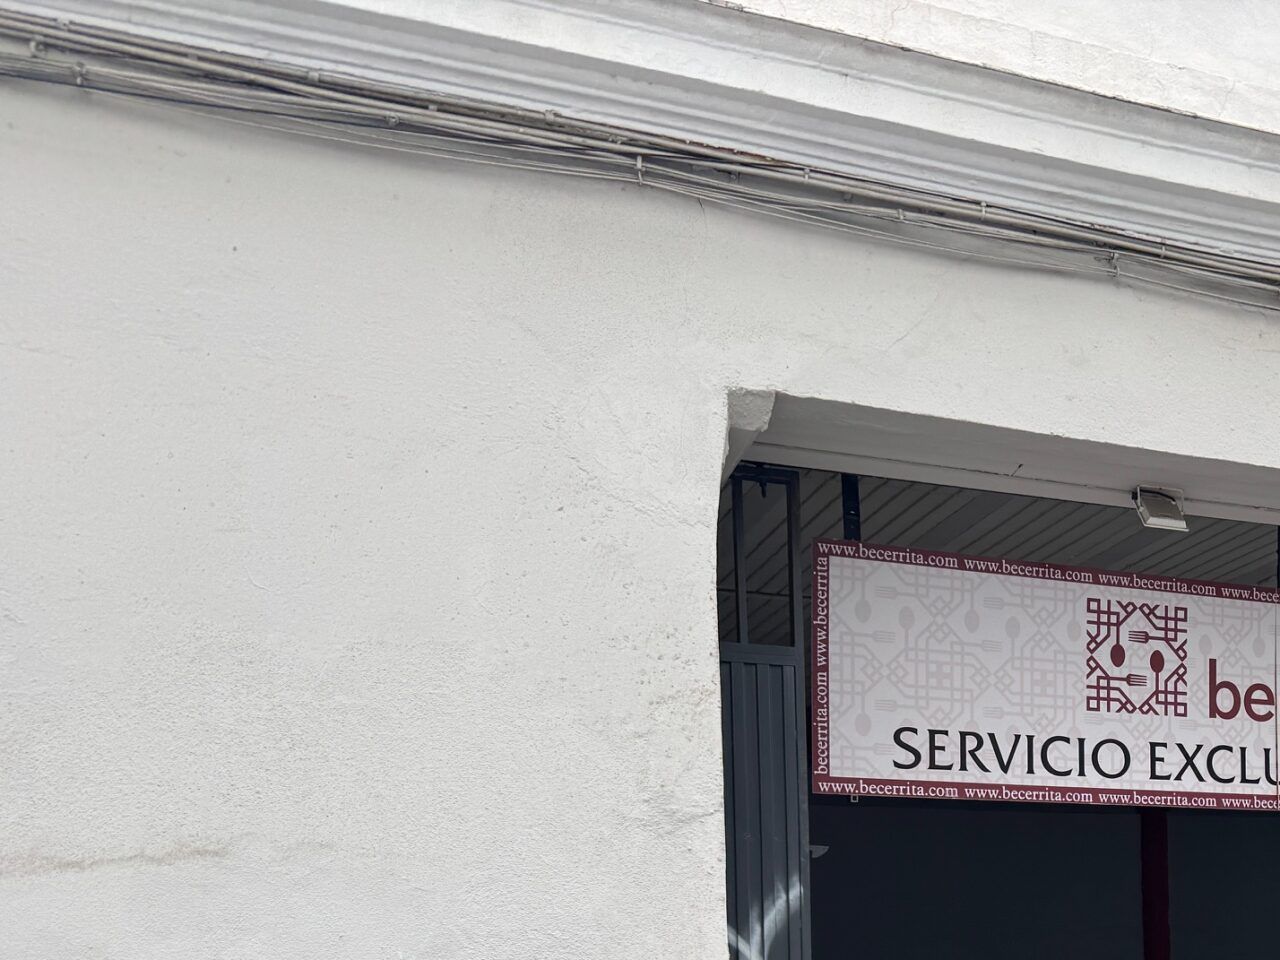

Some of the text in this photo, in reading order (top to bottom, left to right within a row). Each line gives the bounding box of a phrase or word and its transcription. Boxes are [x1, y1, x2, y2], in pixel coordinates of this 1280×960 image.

[817, 542, 959, 568] www.becerrita.com
[964, 558, 1093, 582] www.becerrita.com
[1098, 574, 1217, 596] www.becerrita.com
[813, 556, 828, 775] becerrita.com www.becerrita
[892, 726, 1131, 779] SERVICIO
[817, 780, 959, 797] www.becerrita.com
[964, 786, 1093, 803] www.becerrita.com
[1098, 791, 1217, 807] www.becerrita.com
